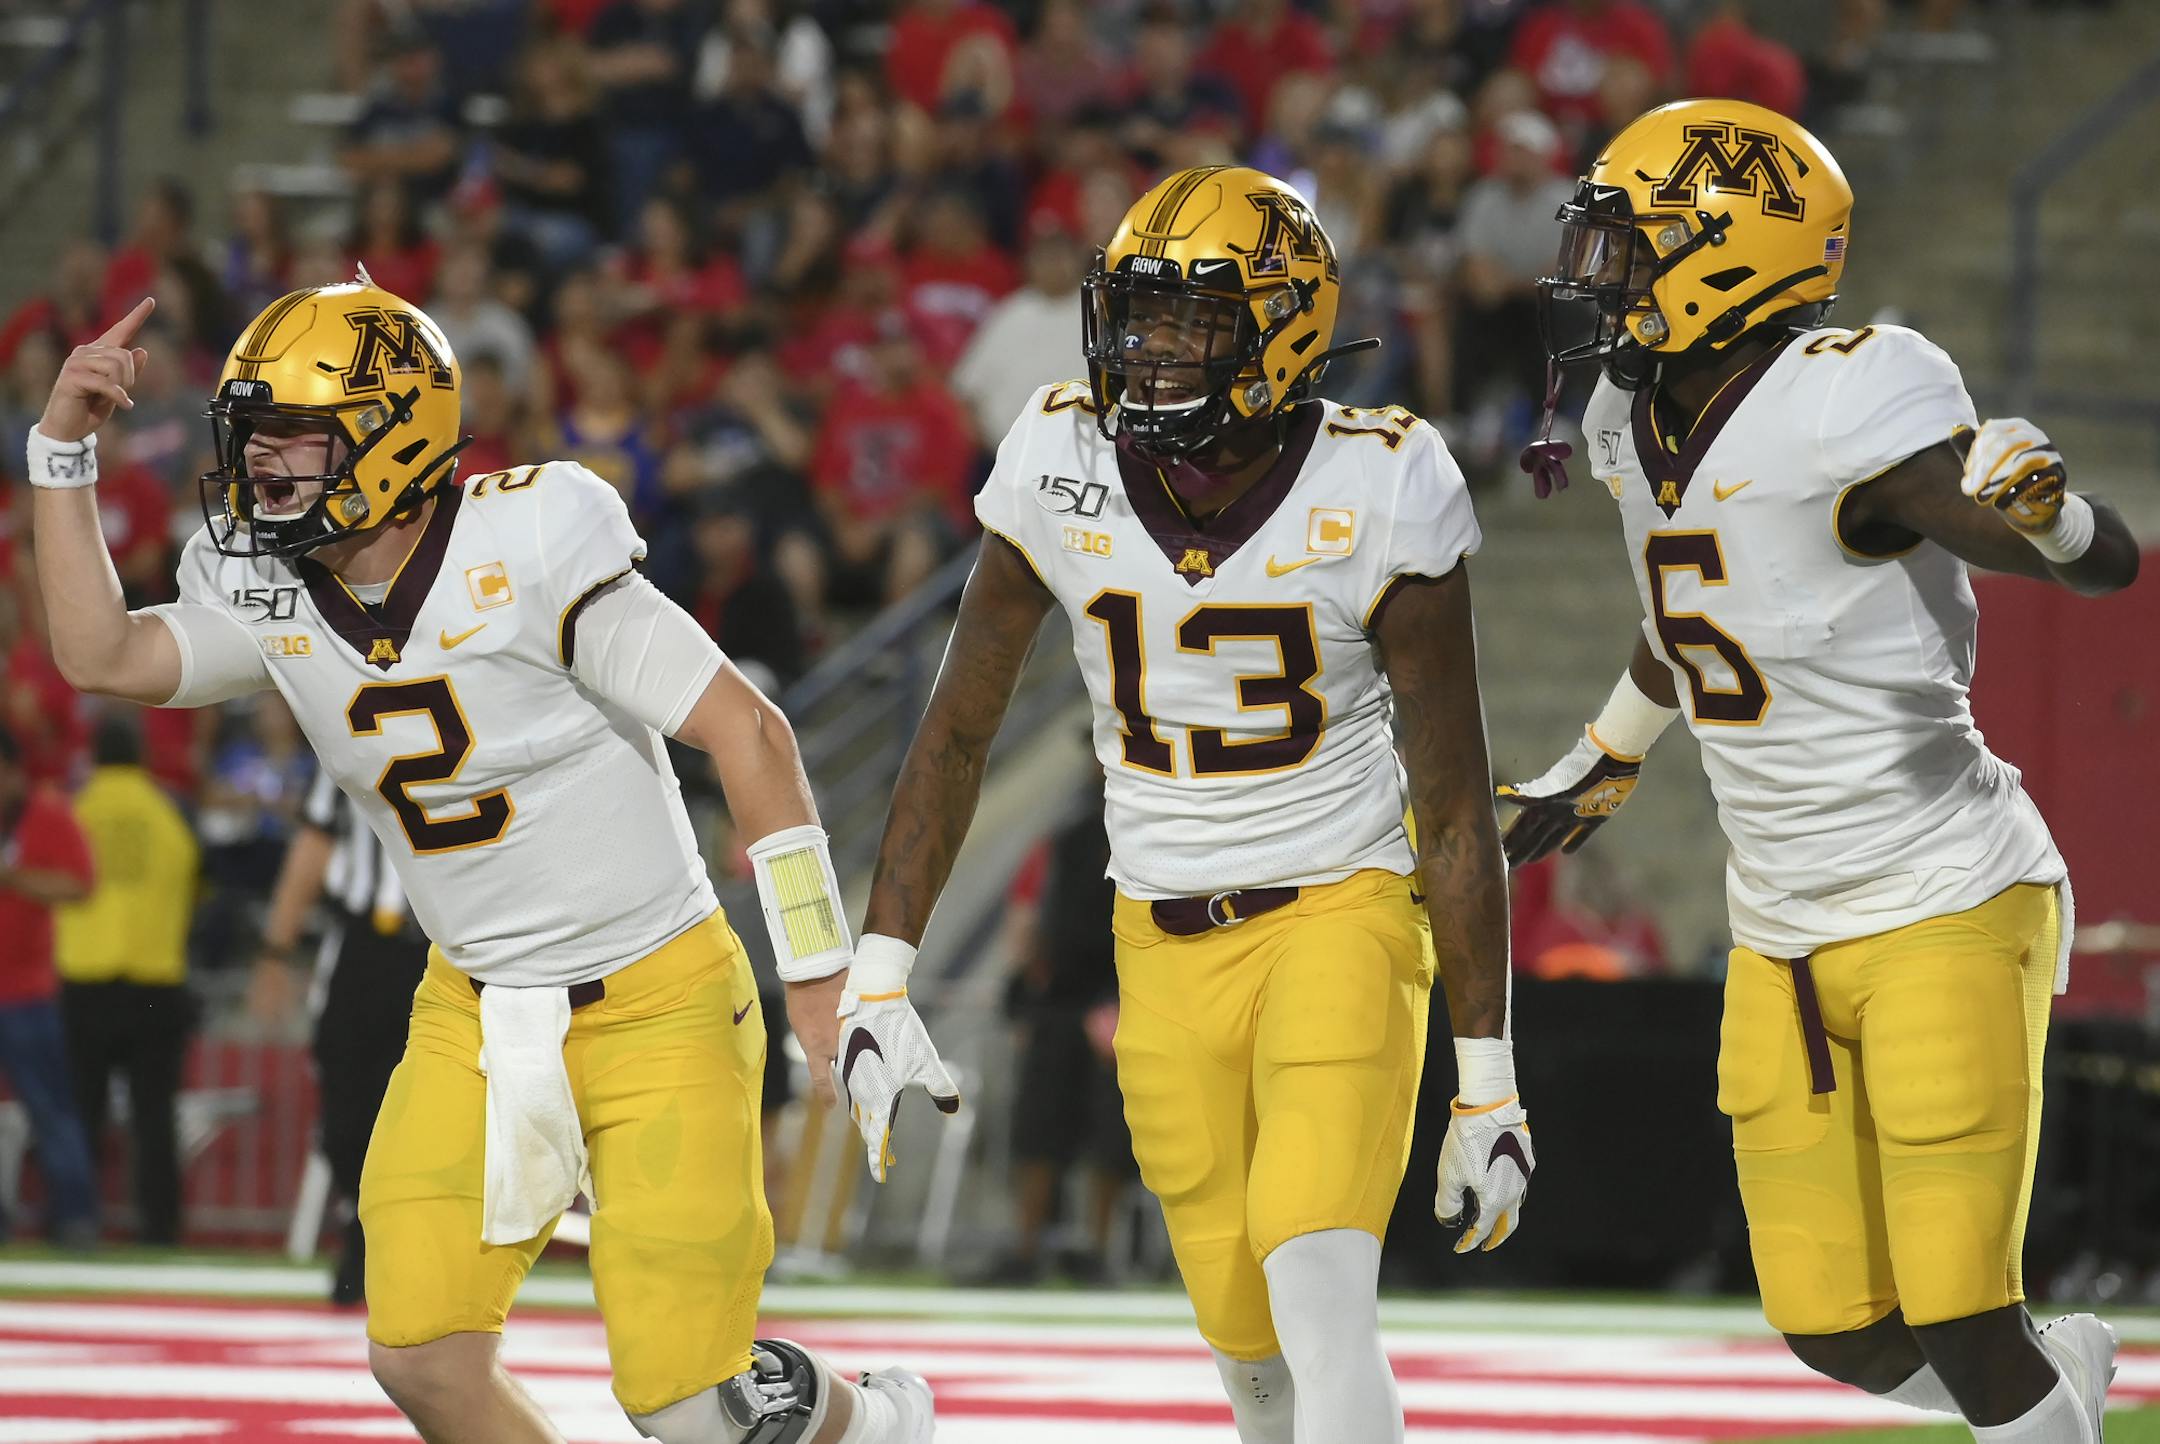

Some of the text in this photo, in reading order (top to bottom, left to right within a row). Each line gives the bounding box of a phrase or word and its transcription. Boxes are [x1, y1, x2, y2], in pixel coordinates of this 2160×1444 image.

[1650, 124, 1806, 222] M
[1245, 188, 1340, 286] M
[340, 308, 455, 396] M
[230, 381, 255, 397] ROW
[1038, 474, 1110, 517] 150
[1656, 480, 1681, 507] M
[1176, 548, 1213, 576] M
[232, 587, 298, 622] 150
[1642, 528, 1772, 726] 6
[366, 638, 400, 662] M
[1083, 586, 1329, 780] 13
[344, 673, 516, 857] 2
